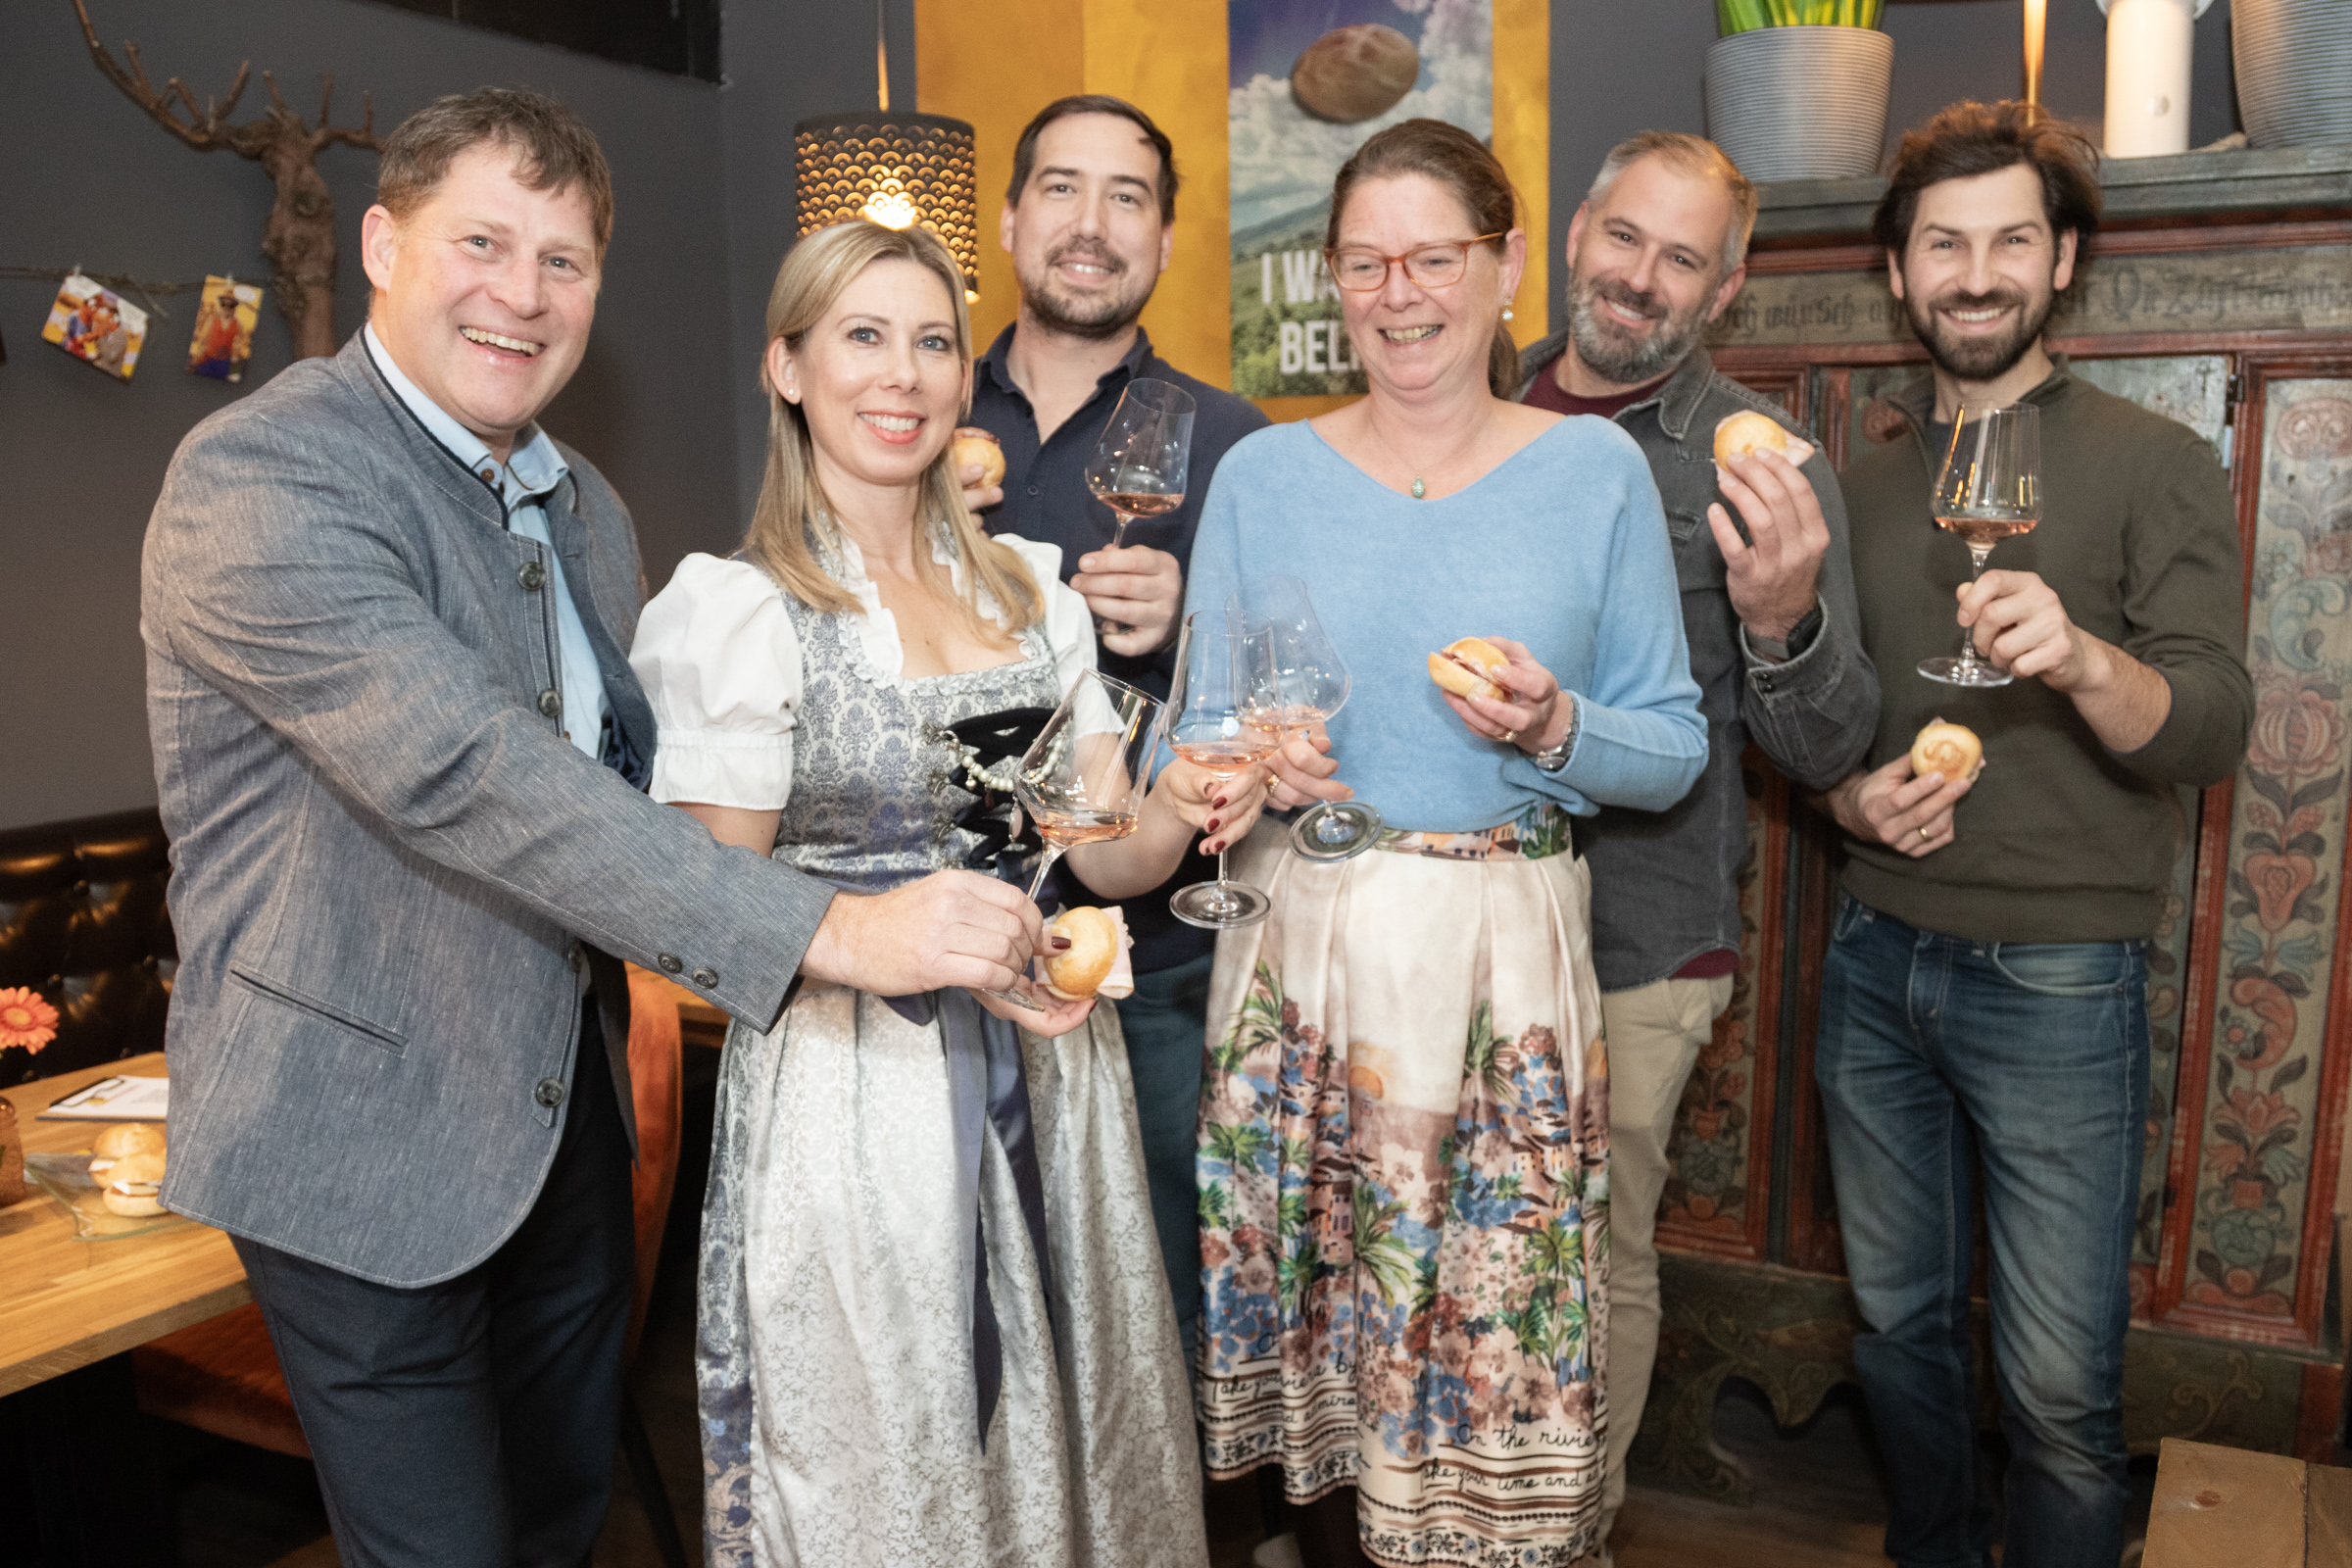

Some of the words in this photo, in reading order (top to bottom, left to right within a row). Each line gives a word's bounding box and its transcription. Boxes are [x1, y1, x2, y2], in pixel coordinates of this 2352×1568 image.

[1261, 252, 1272, 305] I
[1282, 249, 1341, 304] WA
[1456, 1424, 1487, 1446] On
[1493, 1424, 1532, 1451] the
[1496, 1476, 1540, 1492] time
[1544, 1469, 1583, 1488] and
